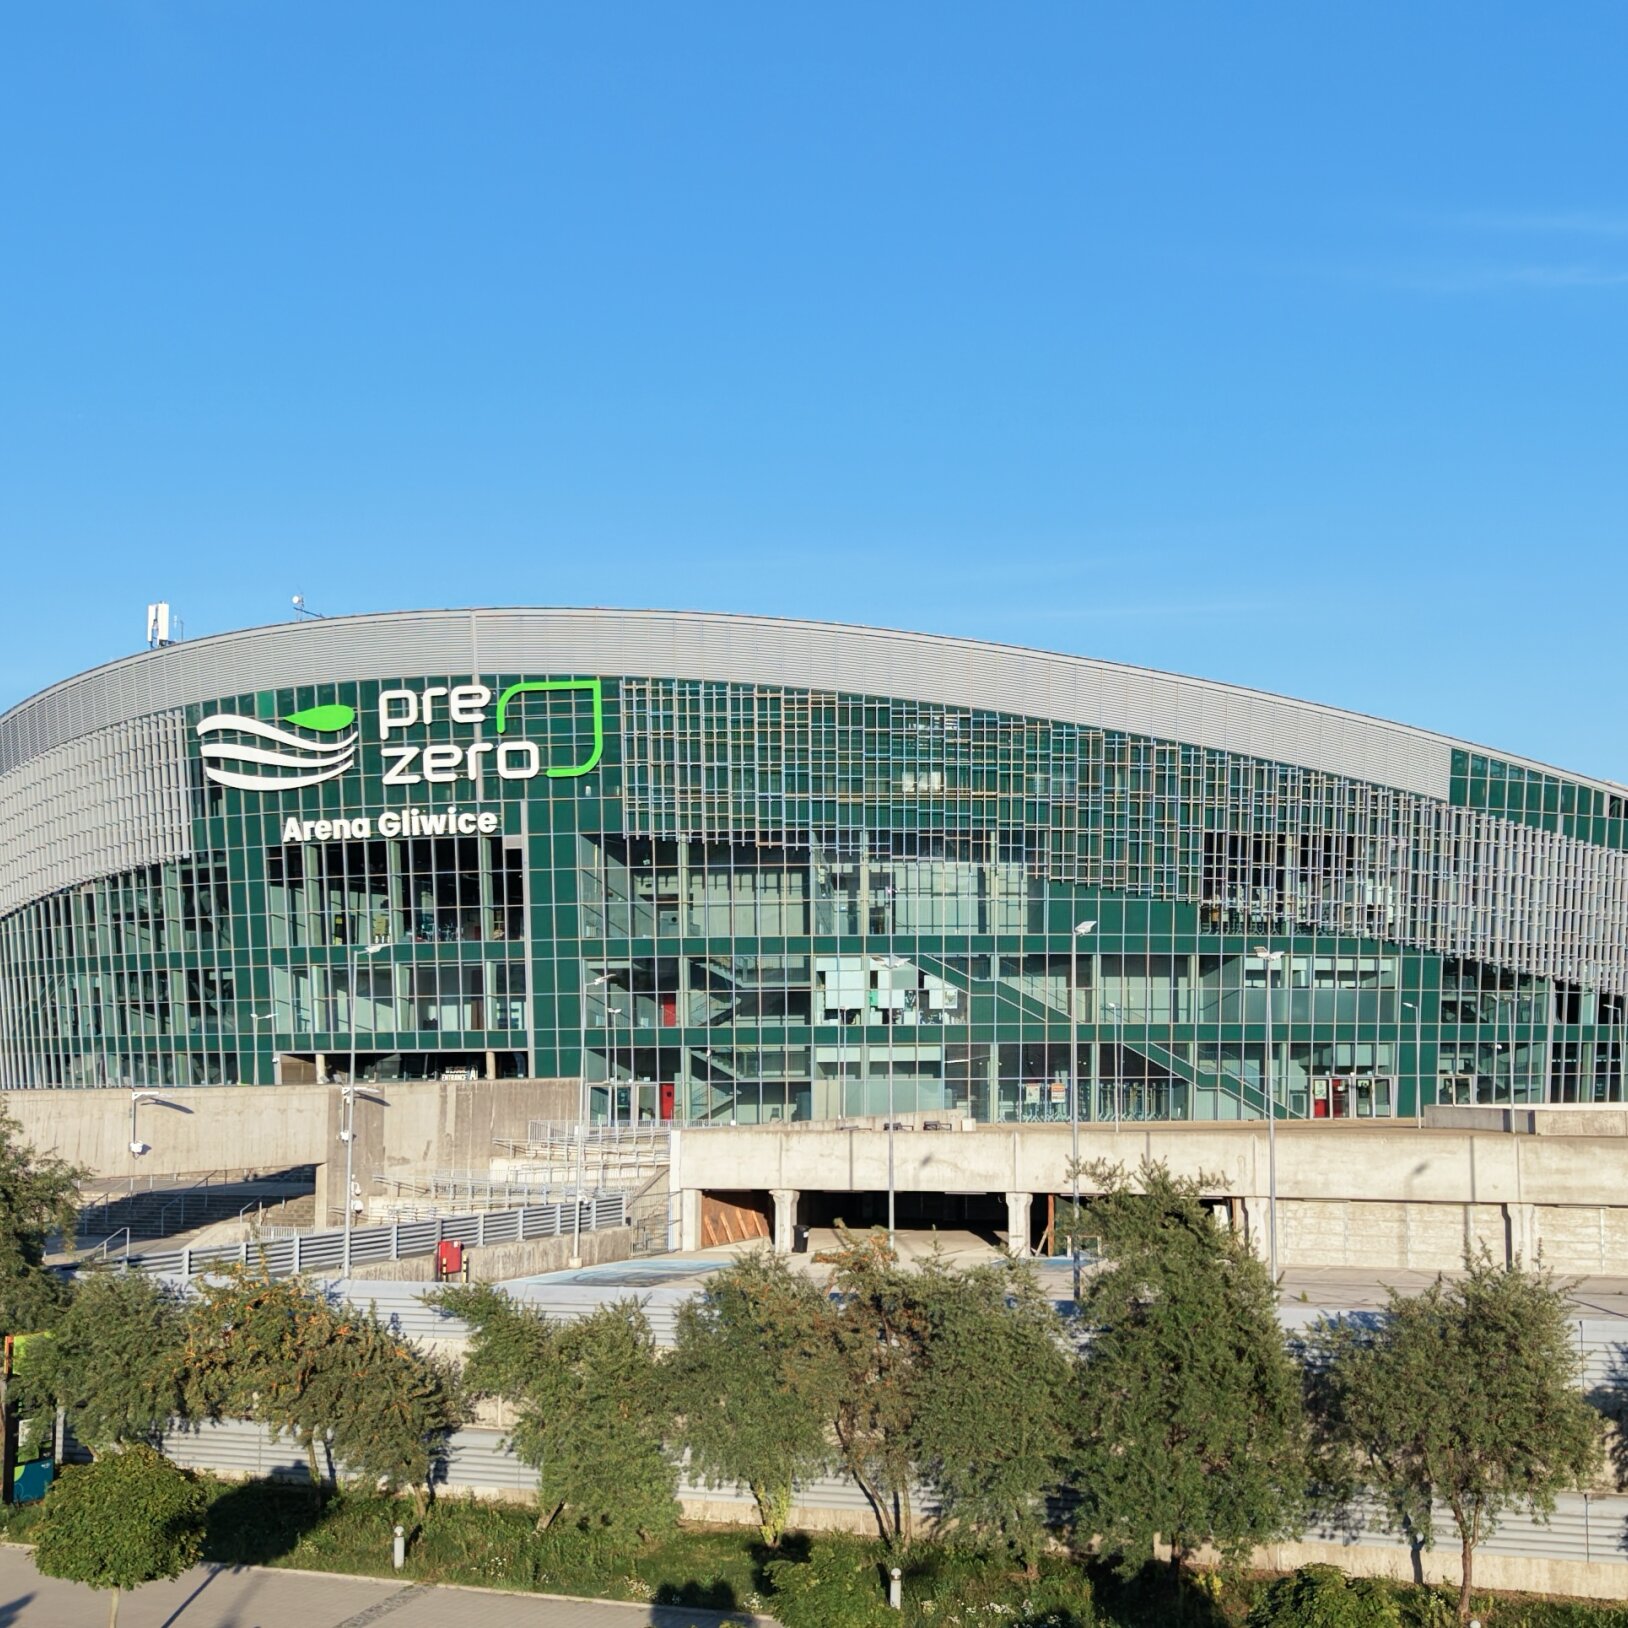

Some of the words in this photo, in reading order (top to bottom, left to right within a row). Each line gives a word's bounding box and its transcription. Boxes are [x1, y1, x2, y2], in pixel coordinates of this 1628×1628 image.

[380, 685, 491, 740] pre
[382, 741, 540, 785] zero
[284, 815, 371, 843] Arena
[379, 807, 499, 838] Gliwice
